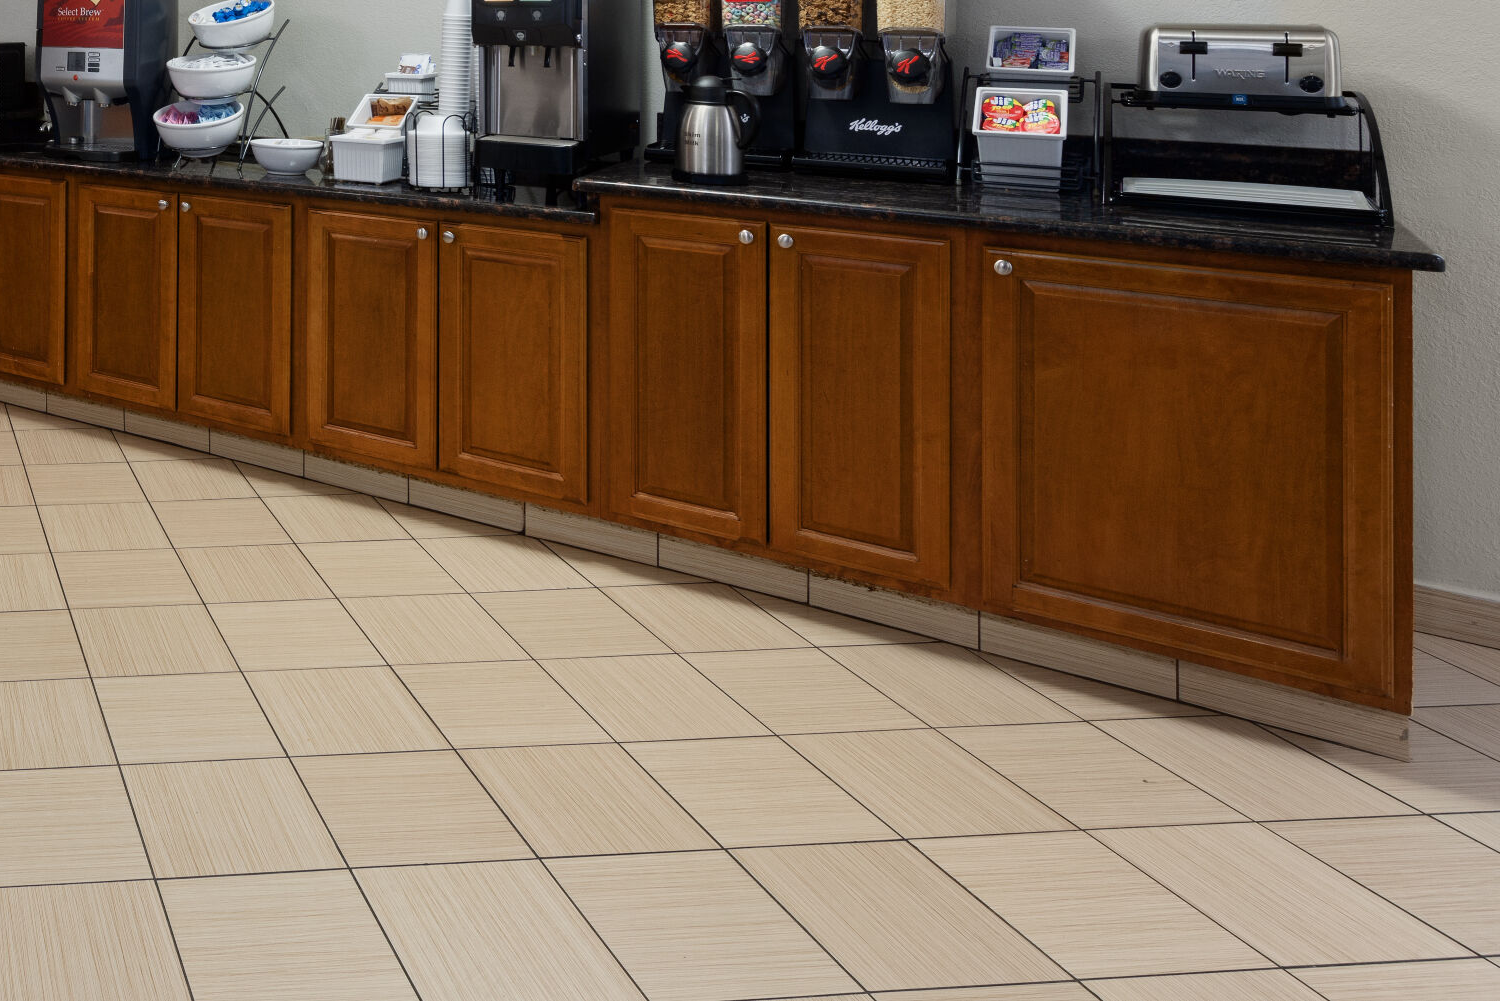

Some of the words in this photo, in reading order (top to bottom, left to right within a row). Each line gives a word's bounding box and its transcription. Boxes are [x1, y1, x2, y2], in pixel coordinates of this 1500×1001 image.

[57, 7, 78, 16] Select
[80, 7, 101, 16] Brew
[849, 118, 902, 135] Kellogg's
